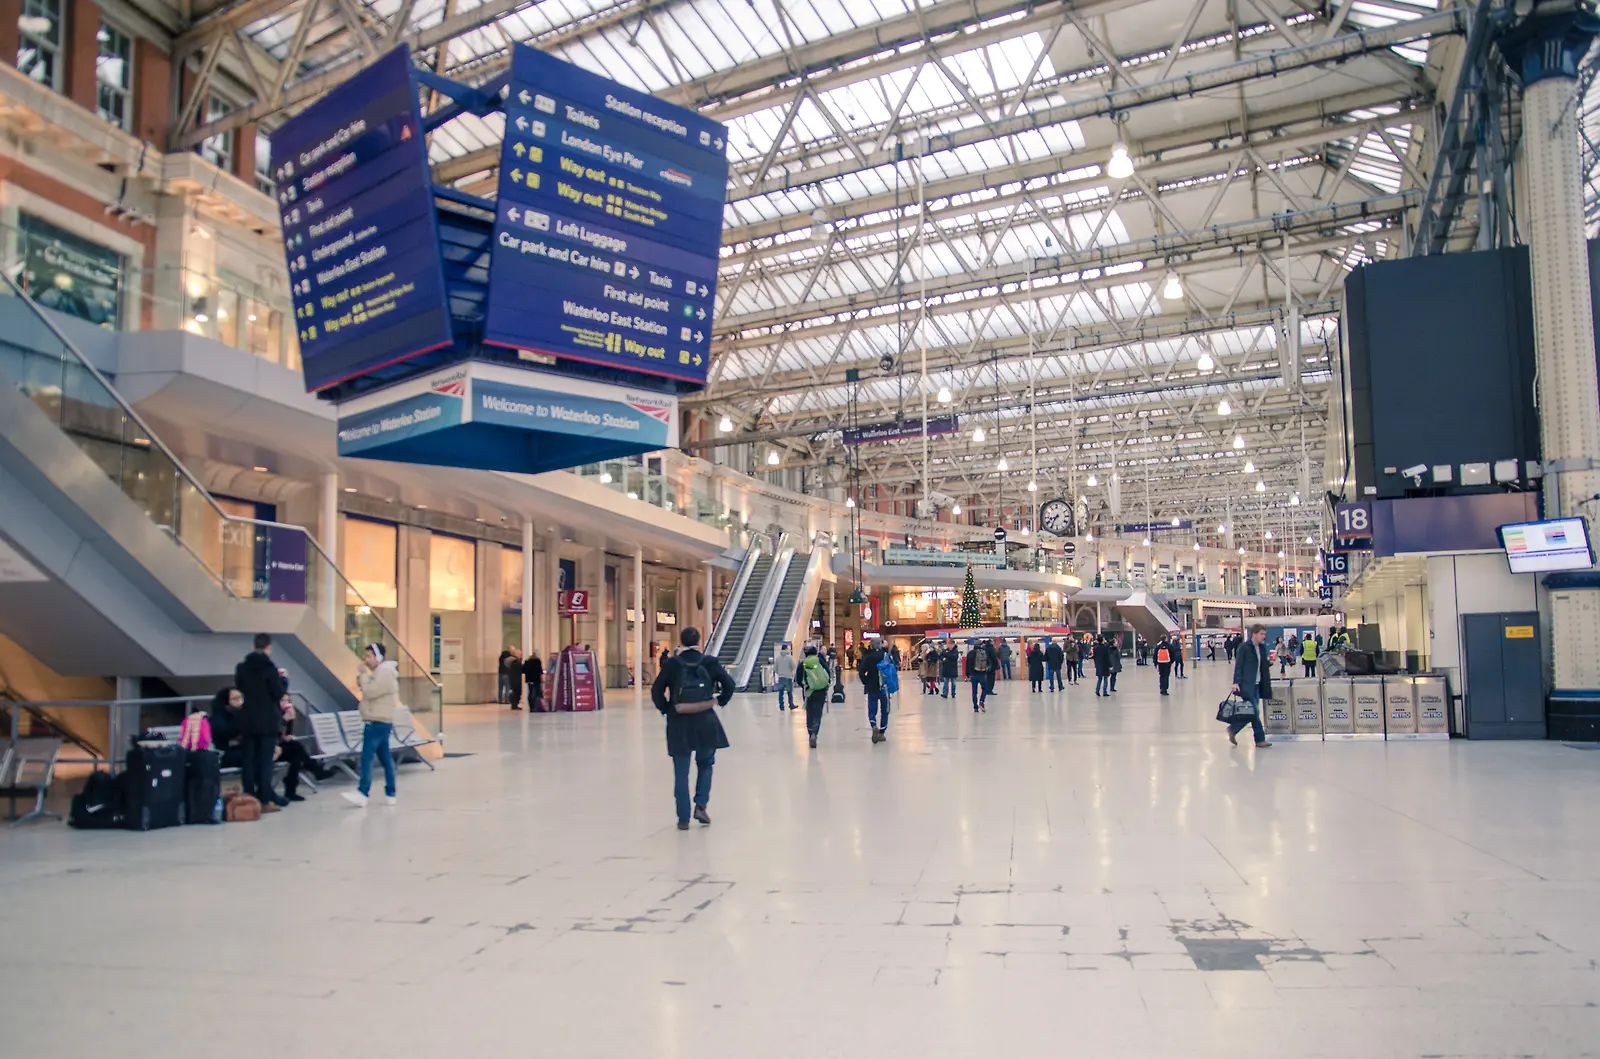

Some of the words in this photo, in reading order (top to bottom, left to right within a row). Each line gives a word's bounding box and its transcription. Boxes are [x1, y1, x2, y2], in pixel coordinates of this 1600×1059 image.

[564, 104, 600, 130] Toilets
[604, 94, 642, 119] Station
[642, 111, 688, 137] reception
[561, 130, 602, 155] London
[603, 144, 623, 164] Eye
[623, 151, 644, 169] Pier
[560, 155, 585, 178] Way
[585, 166, 606, 183] out
[557, 181, 583, 203] Way
[583, 192, 603, 208] out
[556, 219, 580, 239] Left
[580, 226, 628, 253] Luggage
[499, 231, 521, 249] Car
[521, 239, 548, 256] park
[548, 246, 570, 262] and
[570, 250, 589, 268] Car
[590, 254, 611, 273] hire
[649, 270, 673, 289] Taxis
[320, 295, 336, 310] Way
[604, 284, 627, 303] First
[627, 291, 643, 306] aid
[643, 294, 670, 313] point
[323, 319, 339, 333] Way
[562, 300, 610, 323] Waterloo
[610, 311, 633, 329] East
[633, 317, 668, 336] Station
[624, 338, 645, 358] Way
[645, 345, 666, 360] out
[339, 425, 372, 441] Welcome
[372, 423, 380, 434] to
[380, 413, 414, 432] Waterloo
[413, 405, 442, 423] Station
[482, 394, 535, 416] Welcome
[536, 404, 549, 418] to
[550, 405, 601, 425] Waterloo
[602, 413, 640, 431] Station
[862, 429, 888, 439] Waterloo
[888, 428, 900, 436] East
[1340, 508, 1368, 530] 18
[219, 521, 254, 549] Exit
[1327, 556, 1345, 570] 16
[1320, 587, 1331, 597] 14
